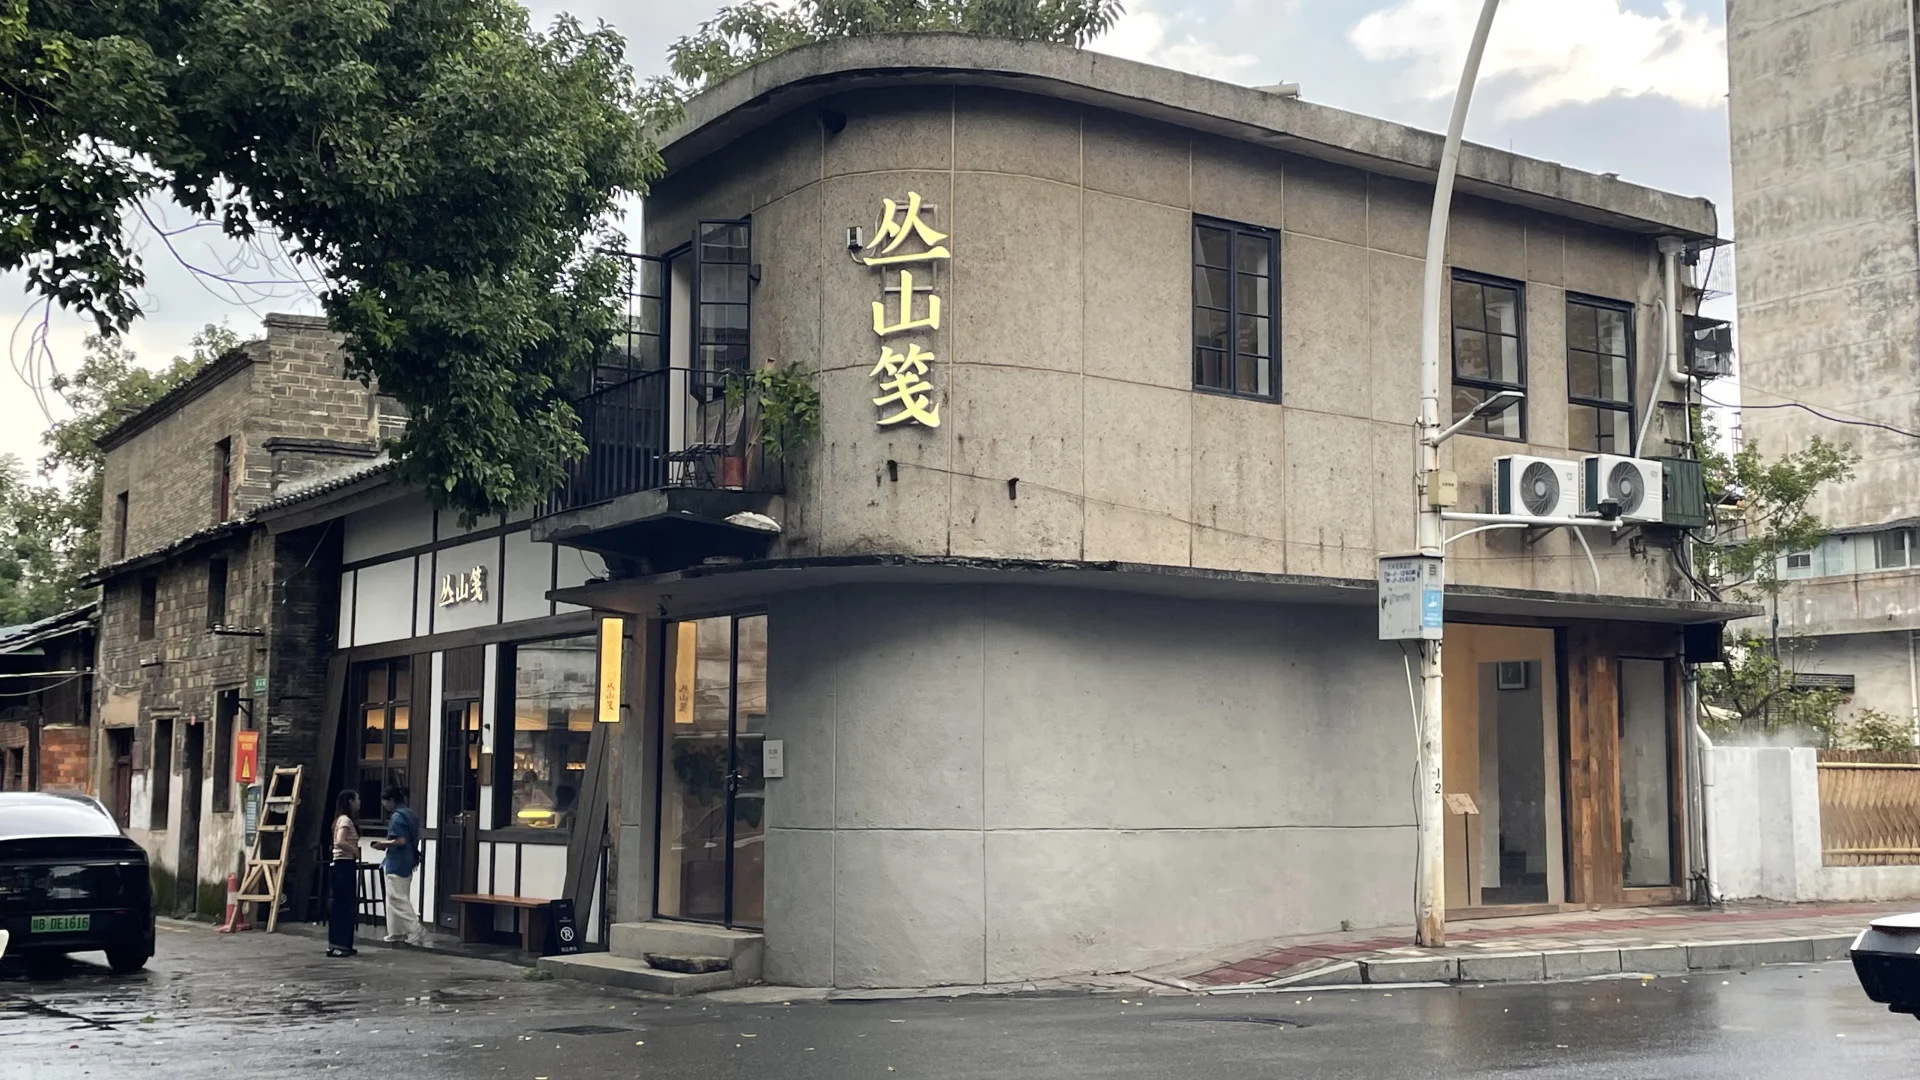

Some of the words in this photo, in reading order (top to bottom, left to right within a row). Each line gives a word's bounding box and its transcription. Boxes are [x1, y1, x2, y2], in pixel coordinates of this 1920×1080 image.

[863, 191, 950, 427] 丛山笺
[439, 566, 483, 607] 丛山笺
